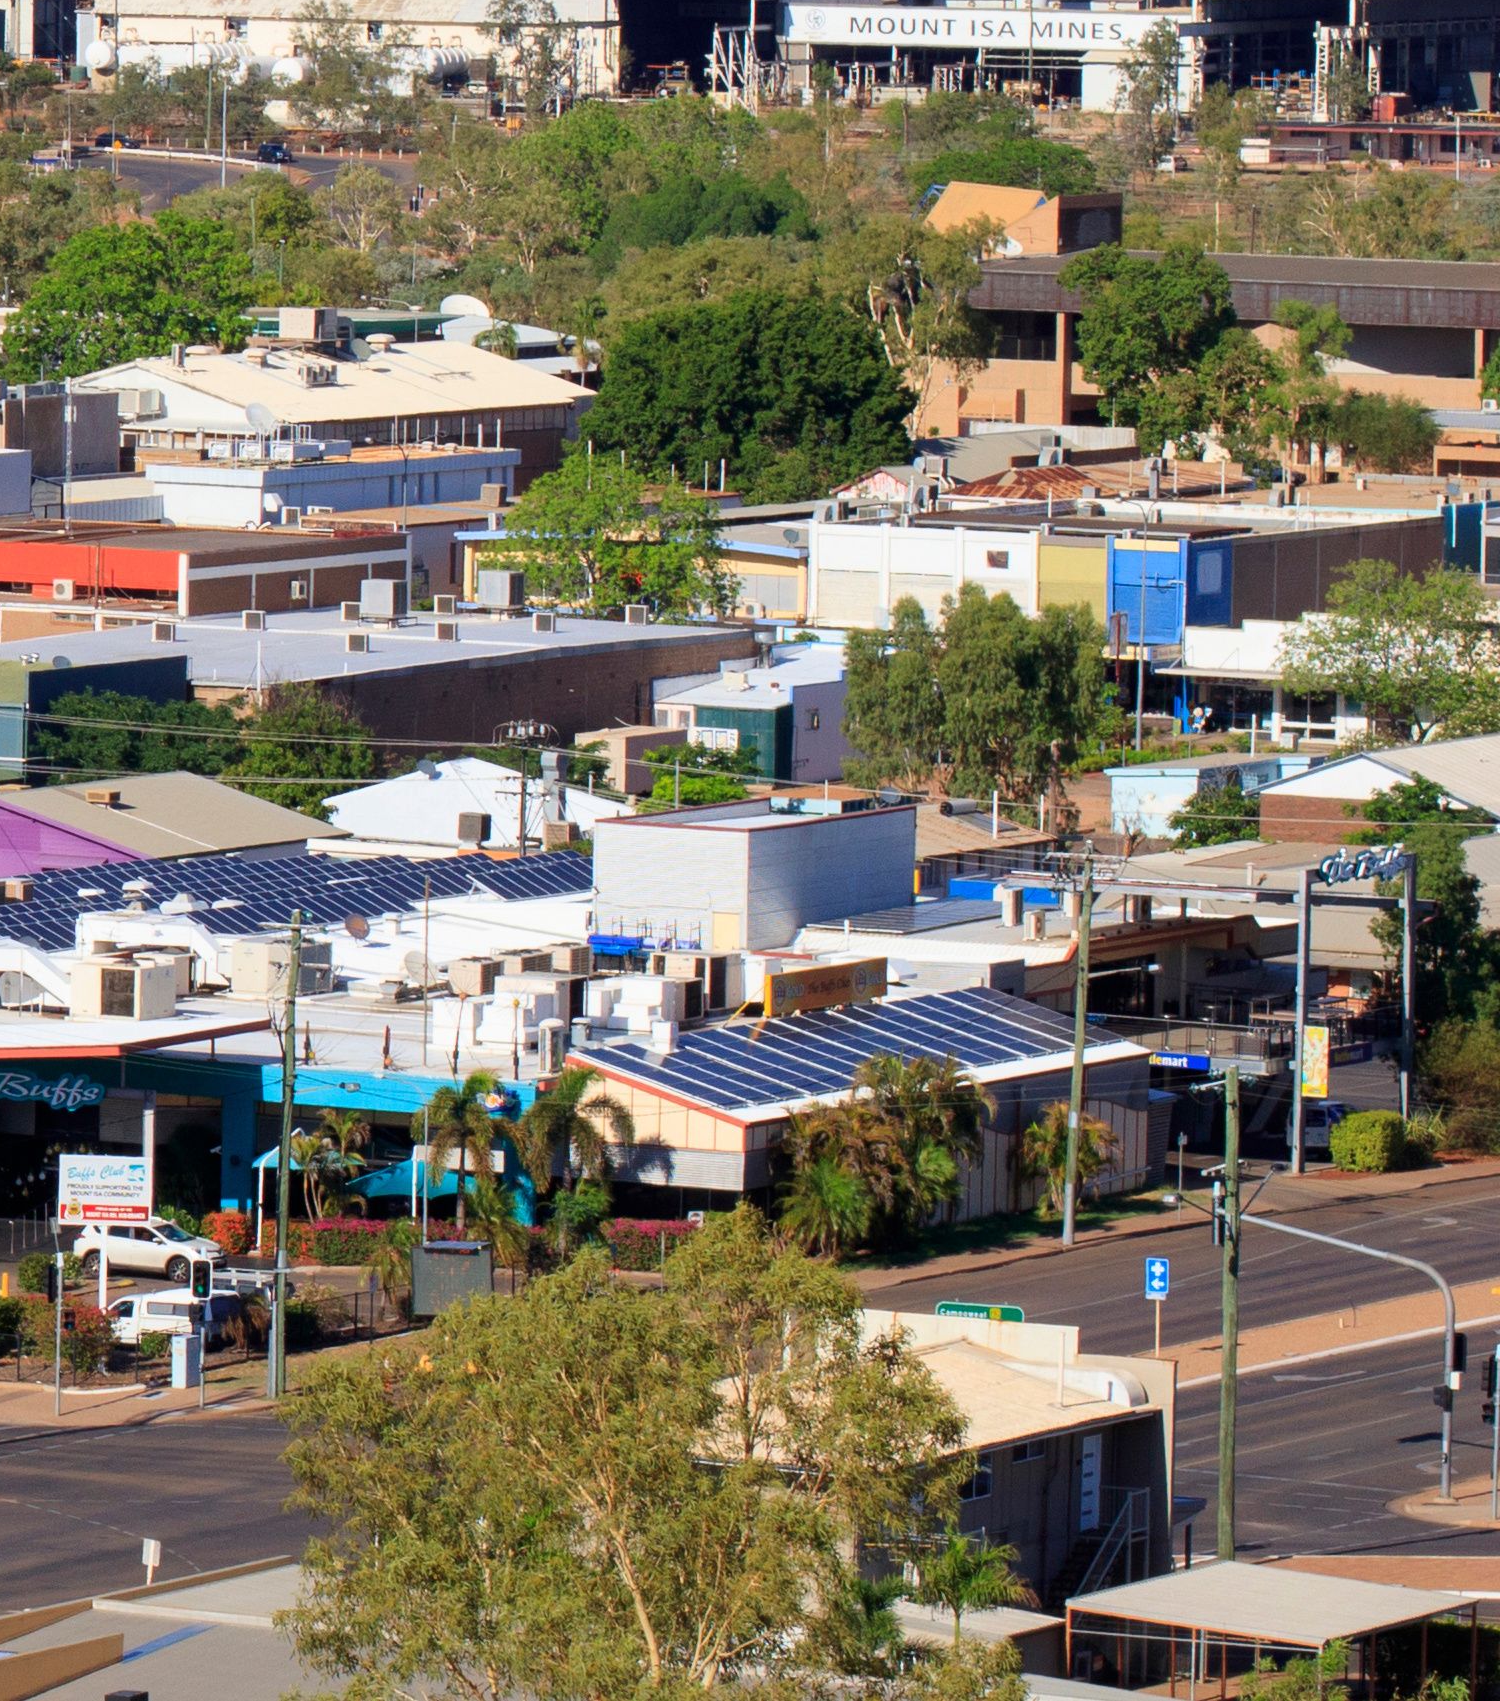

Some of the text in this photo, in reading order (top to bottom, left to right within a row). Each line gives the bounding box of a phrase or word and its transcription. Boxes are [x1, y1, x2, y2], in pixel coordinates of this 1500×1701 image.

[849, 16, 1123, 42] MOUNT ISA MINES
[66, 1164, 126, 1182] Buffs Club
